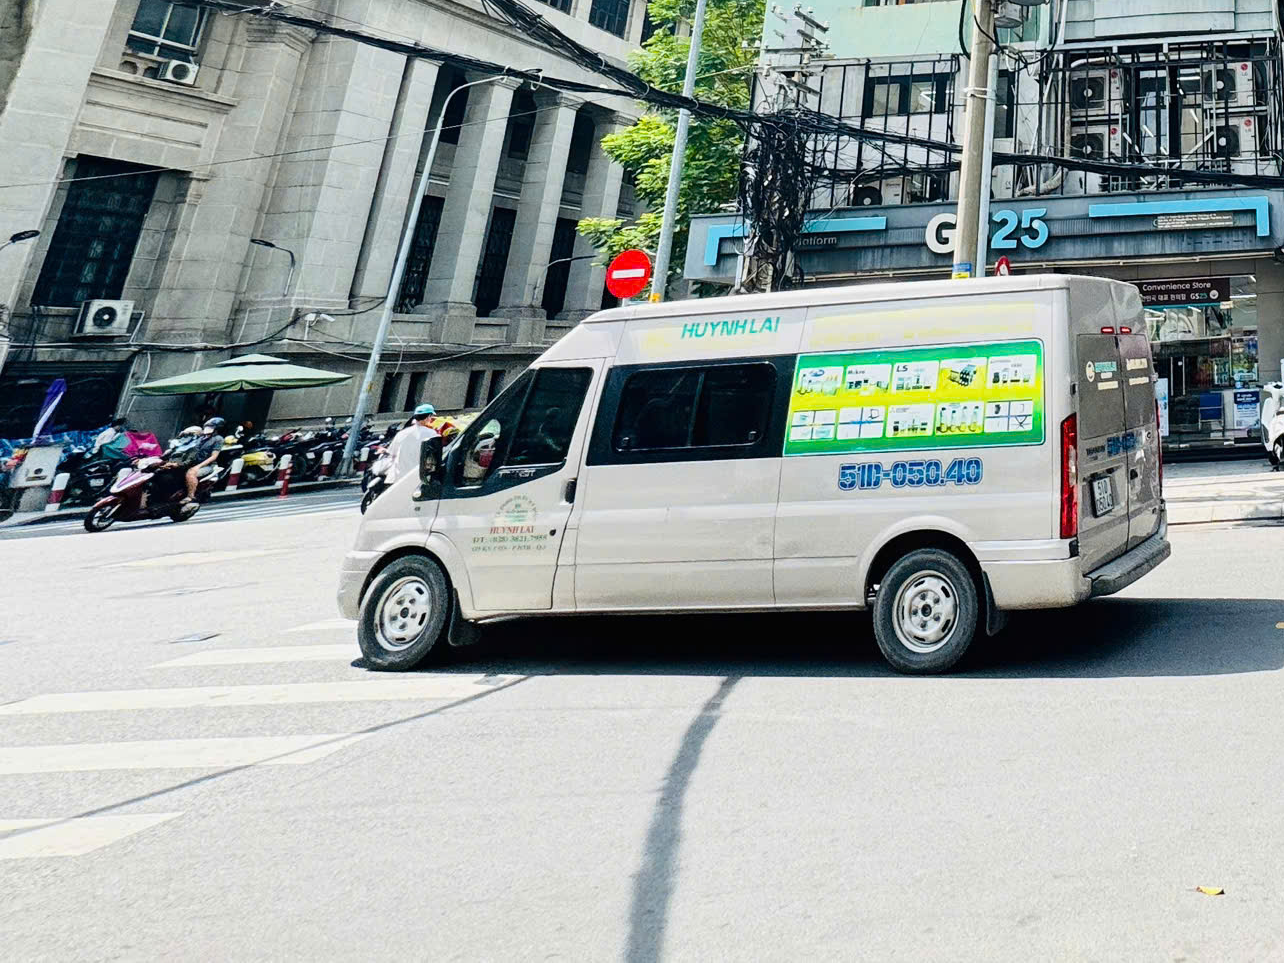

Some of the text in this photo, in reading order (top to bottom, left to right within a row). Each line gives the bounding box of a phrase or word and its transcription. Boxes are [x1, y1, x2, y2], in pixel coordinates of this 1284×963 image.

[925, 208, 1049, 254] G25
[1142, 281, 1211, 291] Convenience Store
[681, 317, 782, 339] HUYNH LAI
[838, 457, 984, 491] 51D-050.40
